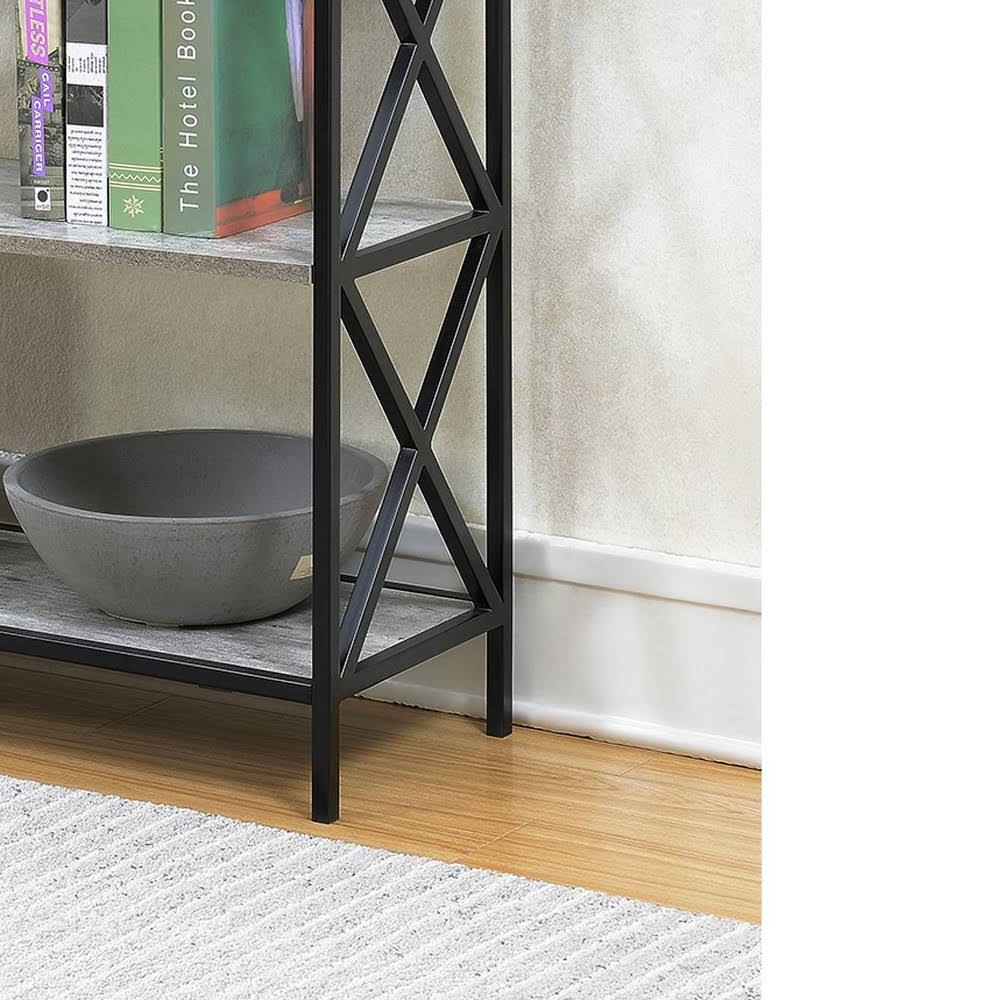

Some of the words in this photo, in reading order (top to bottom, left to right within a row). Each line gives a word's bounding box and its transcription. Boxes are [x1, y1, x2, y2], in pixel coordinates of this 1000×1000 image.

[41, 72, 51, 107] GAIL
[178, 75, 199, 149] Hotel
[179, 165, 199, 211] The
